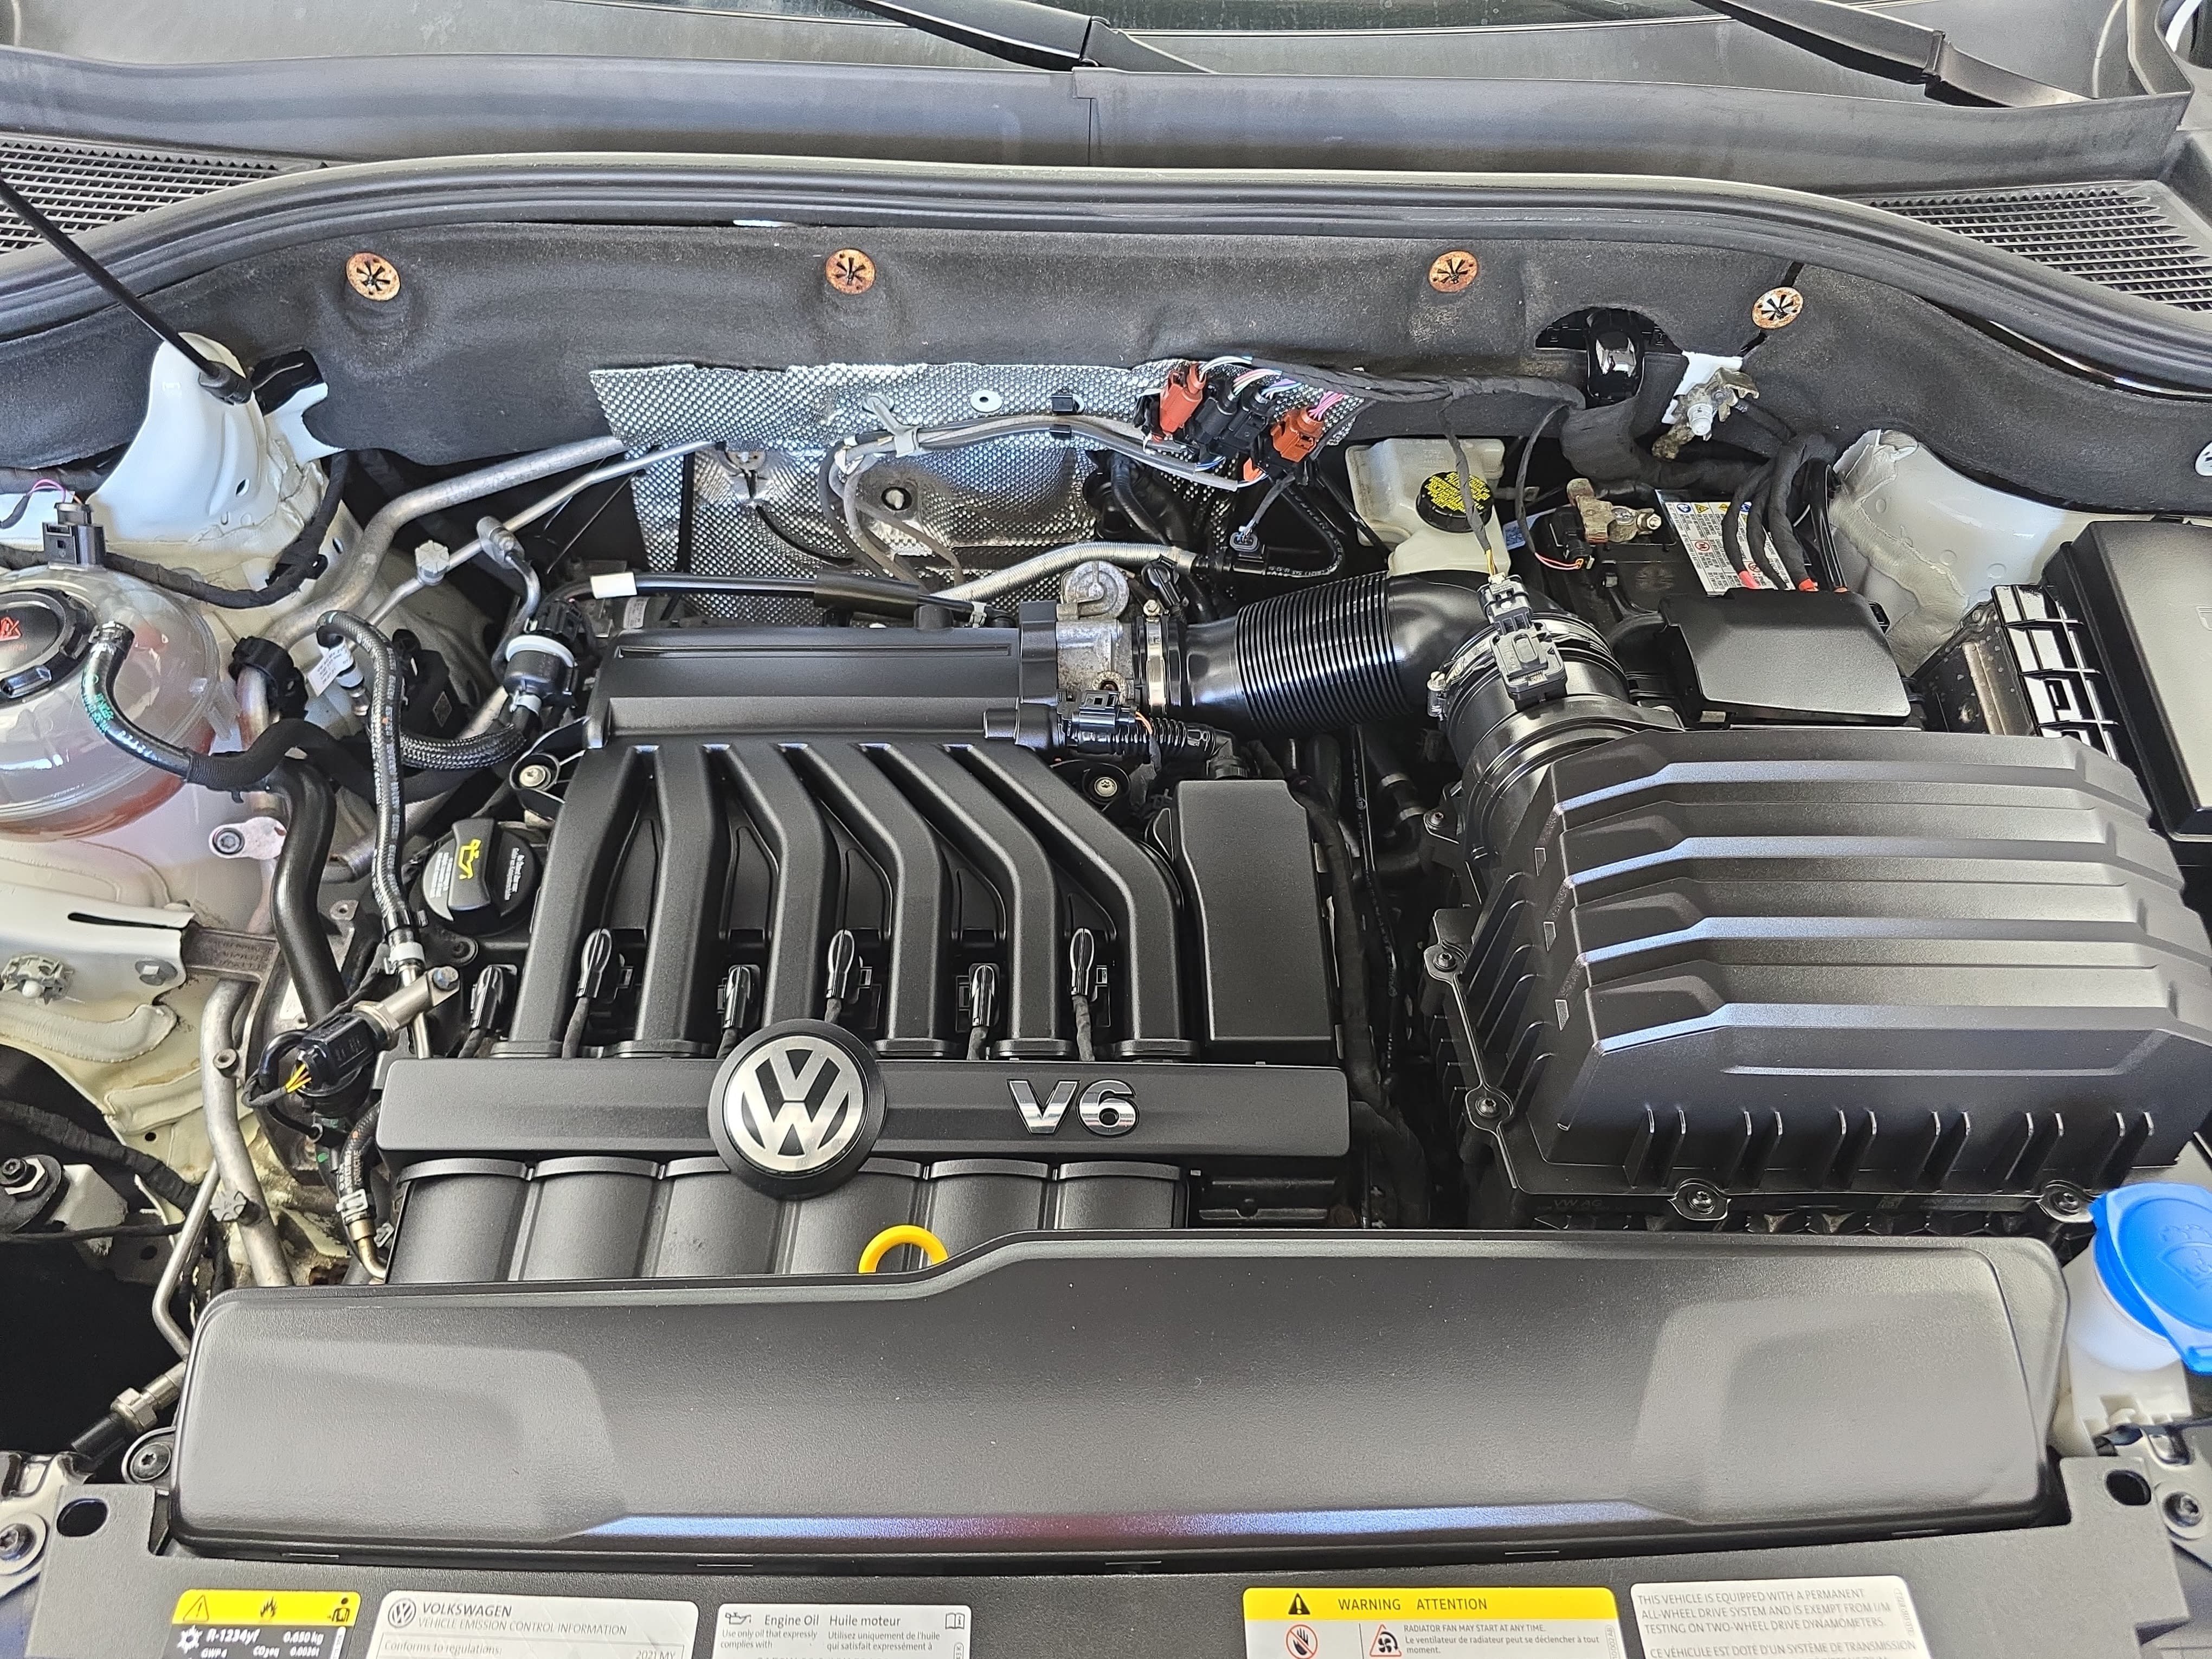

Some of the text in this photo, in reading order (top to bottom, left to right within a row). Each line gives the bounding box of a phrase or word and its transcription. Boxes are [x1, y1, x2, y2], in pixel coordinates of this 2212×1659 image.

[1007, 1079, 1139, 1137] V6
[1637, 1588, 1864, 1605] THIS VEHICLE IS EQUIPPED WITH A PERMANENT
[423, 1602, 512, 1617] VOLKSWAGEN
[1338, 1598, 1488, 1611] WARNING ATTENTION
[1642, 1608, 1696, 1619] ALL-WHEEL
[1698, 1607, 1728, 1618] DRIVE
[1729, 1605, 1767, 1617] SYSTEM
[1769, 1605, 1790, 1615] AND
[1793, 1605, 1802, 1615] IS
[1804, 1603, 1842, 1615] EXEMPT
[1844, 1602, 1873, 1613] FROM
[419, 1617, 628, 1635] VEHICLE EMISSION CONTROL INFORMATION
[764, 1614, 819, 1629] Engine Oil
[829, 1615, 901, 1626] Huile moteur
[1644, 1617, 1886, 1634] TESTING ON TWO-WHEEL DRIVE DYNAMOMETERS.
[722, 1629, 818, 1641] Use only oil that expressly
[828, 1631, 941, 1642] Utilisez uniquement de l'huile
[1470, 1636, 1504, 1644] radiateur
[1506, 1636, 1523, 1645] peut
[384, 1639, 431, 1651] Conforms
[434, 1641, 443, 1651] to
[721, 1640, 773, 1650] complies with
[827, 1642, 933, 1652] qui satisfait expressément à
[1650, 1639, 1917, 1659] CE VÉHICULE EST DOTÉ D'UN SYSTÈME DE TRANSMISSION
